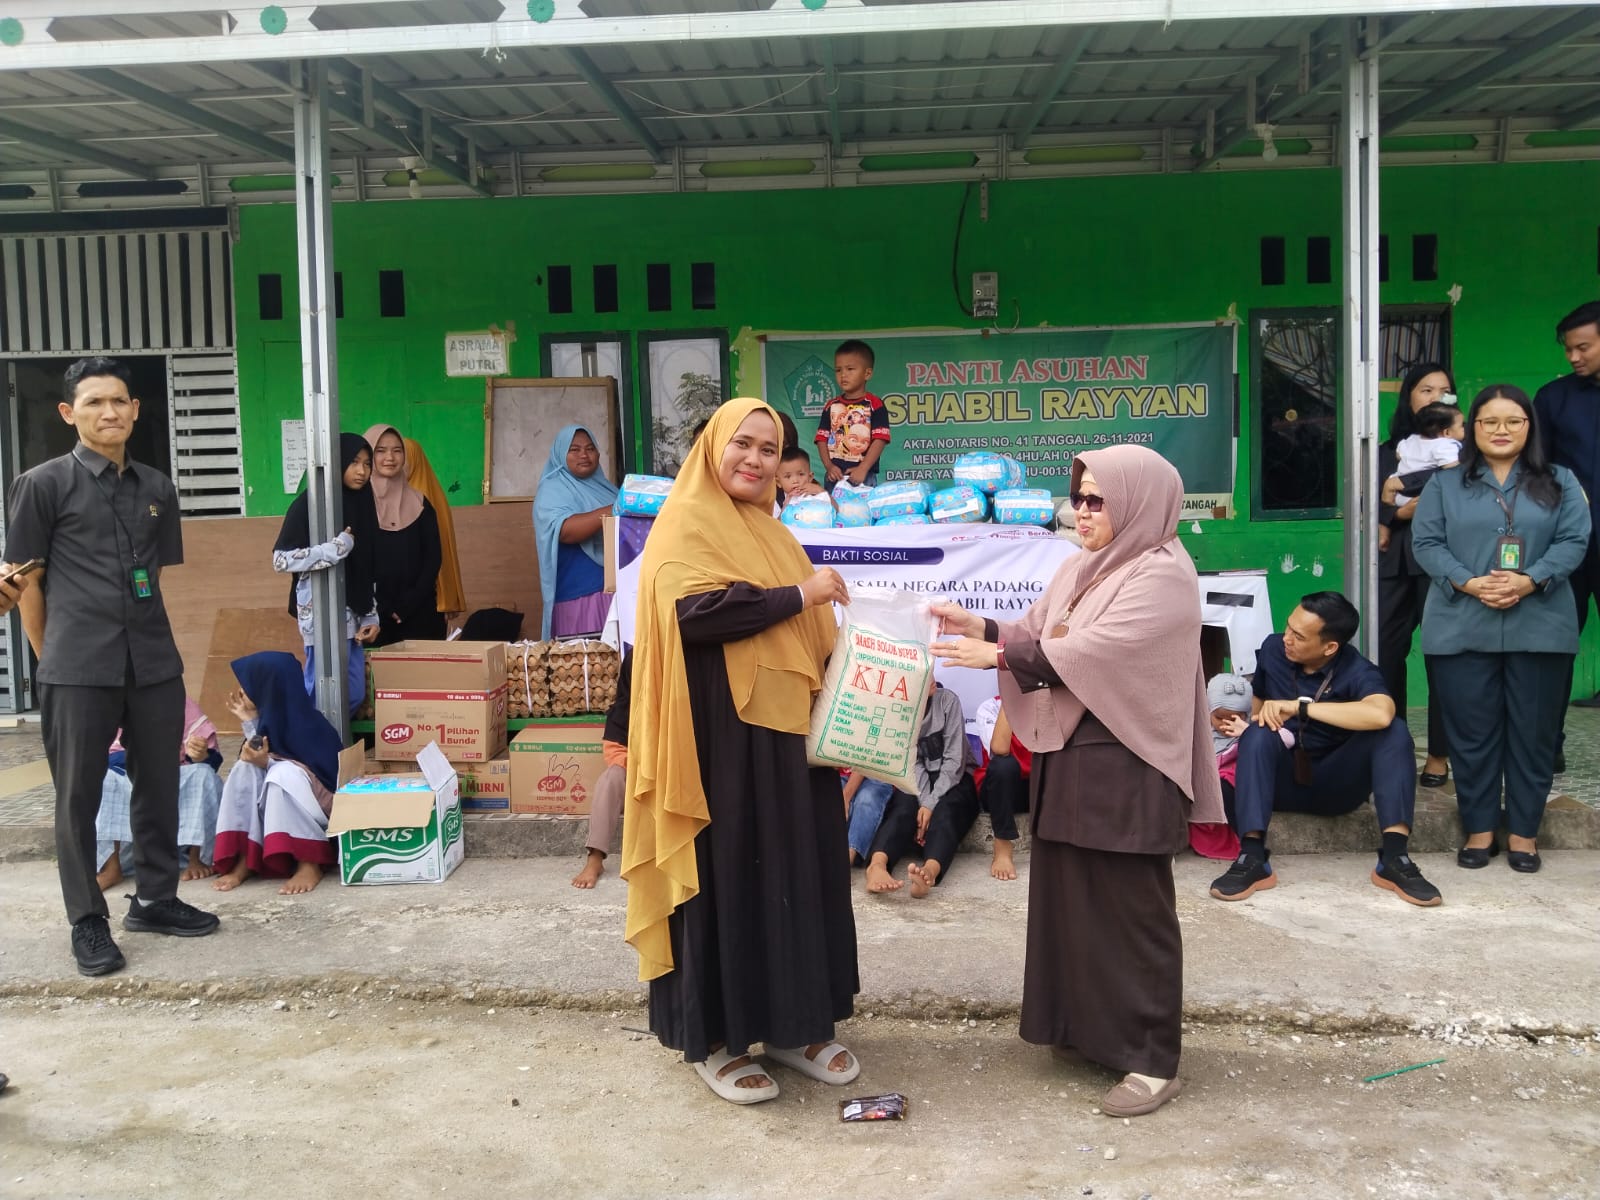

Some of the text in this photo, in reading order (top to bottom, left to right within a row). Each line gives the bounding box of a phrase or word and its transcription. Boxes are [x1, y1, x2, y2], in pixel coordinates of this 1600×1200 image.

[449, 340, 500, 352] ASRAMA
[460, 359, 496, 370] PUTRI
[907, 355, 1149, 386] PANTI ASUHAN
[884, 384, 1208, 425] SHABIL RAYYAN
[903, 433, 1154, 450] AKTA NOTARIS NO. 41 TANGGAL 26-11-2021
[886, 470, 933, 481] DAFTAR
[823, 549, 909, 562] BAKTI SOSIAL
[903, 580, 969, 593] NEGARA
[973, 580, 1043, 593] PADANG
[899, 661, 916, 672] OLEH
[851, 664, 909, 701] KIA
[384, 727, 410, 740] SGM
[418, 724, 480, 745] No. 1 Pilihan
[447, 737, 477, 745] Bunda
[466, 780, 505, 793] MURNI
[540, 779, 563, 791] SGM
[360, 829, 414, 842] SMS
